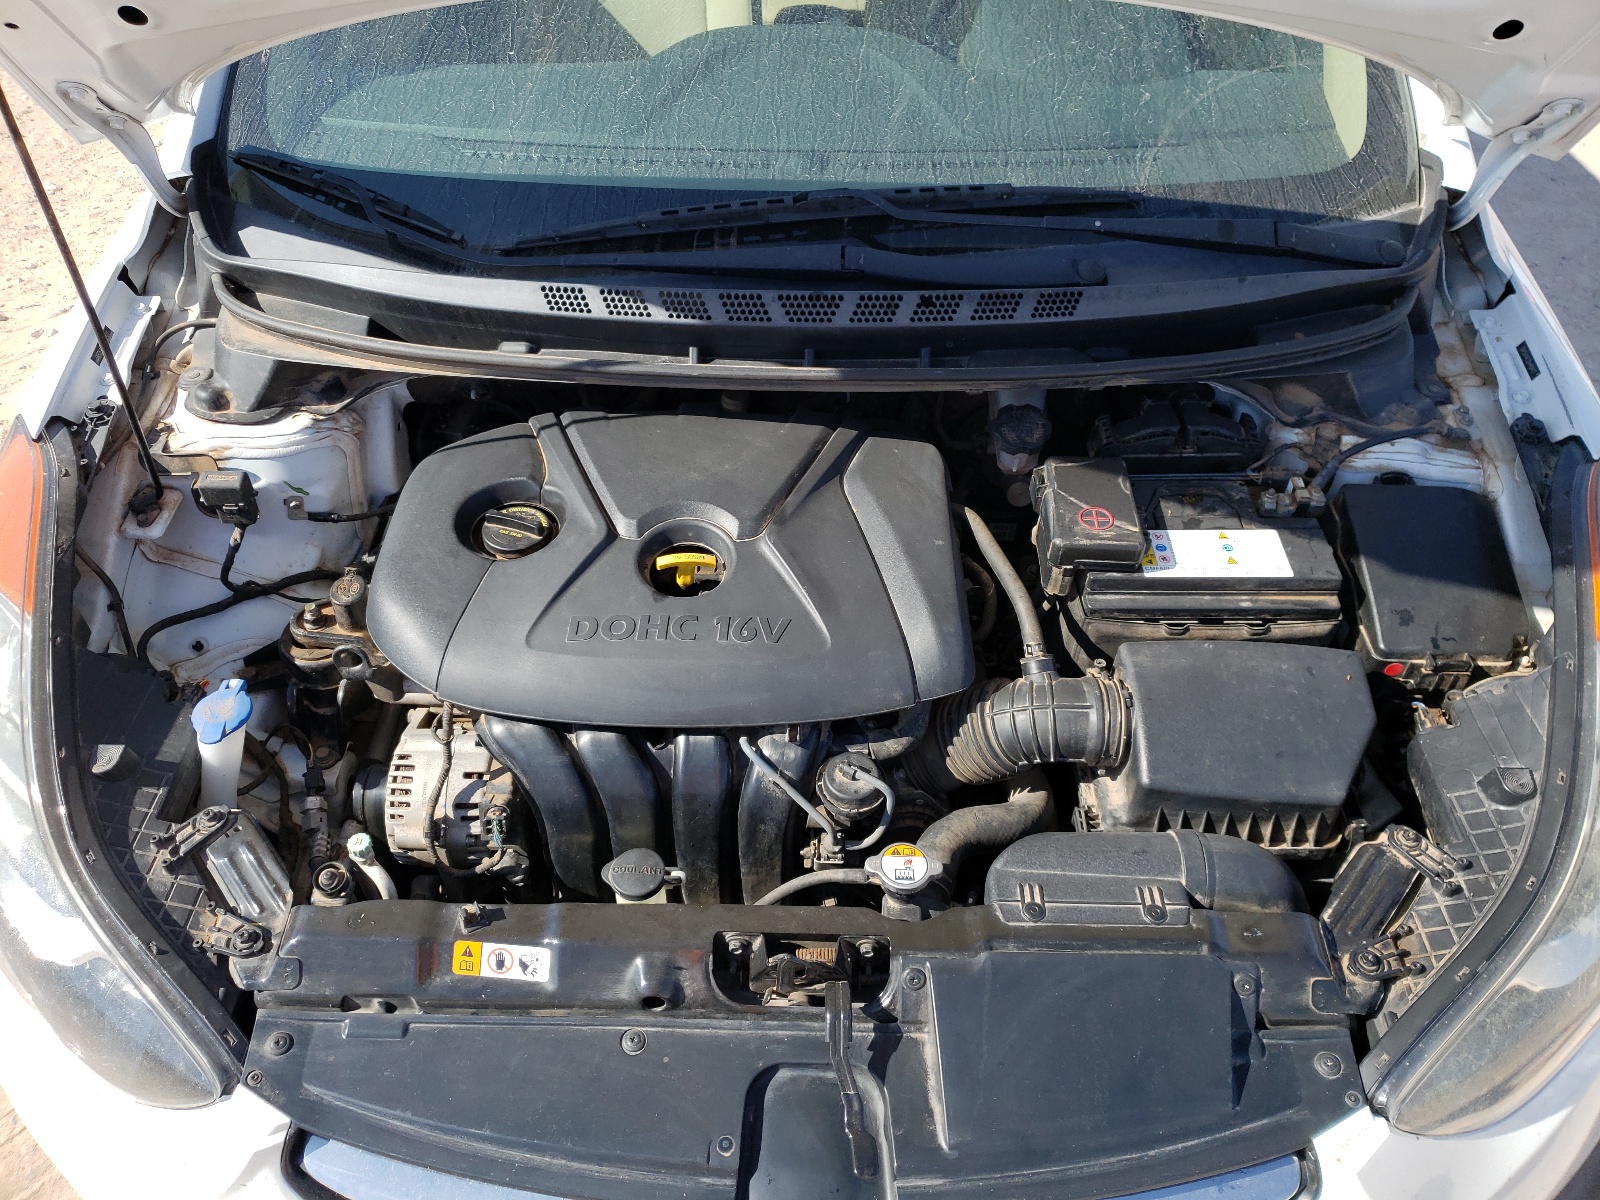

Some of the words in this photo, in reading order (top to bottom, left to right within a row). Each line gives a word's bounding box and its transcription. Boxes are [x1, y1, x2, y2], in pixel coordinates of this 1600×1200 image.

[565, 614, 699, 643] DOHC
[715, 615, 793, 644] 16V
[612, 864, 662, 875] COOLANT
